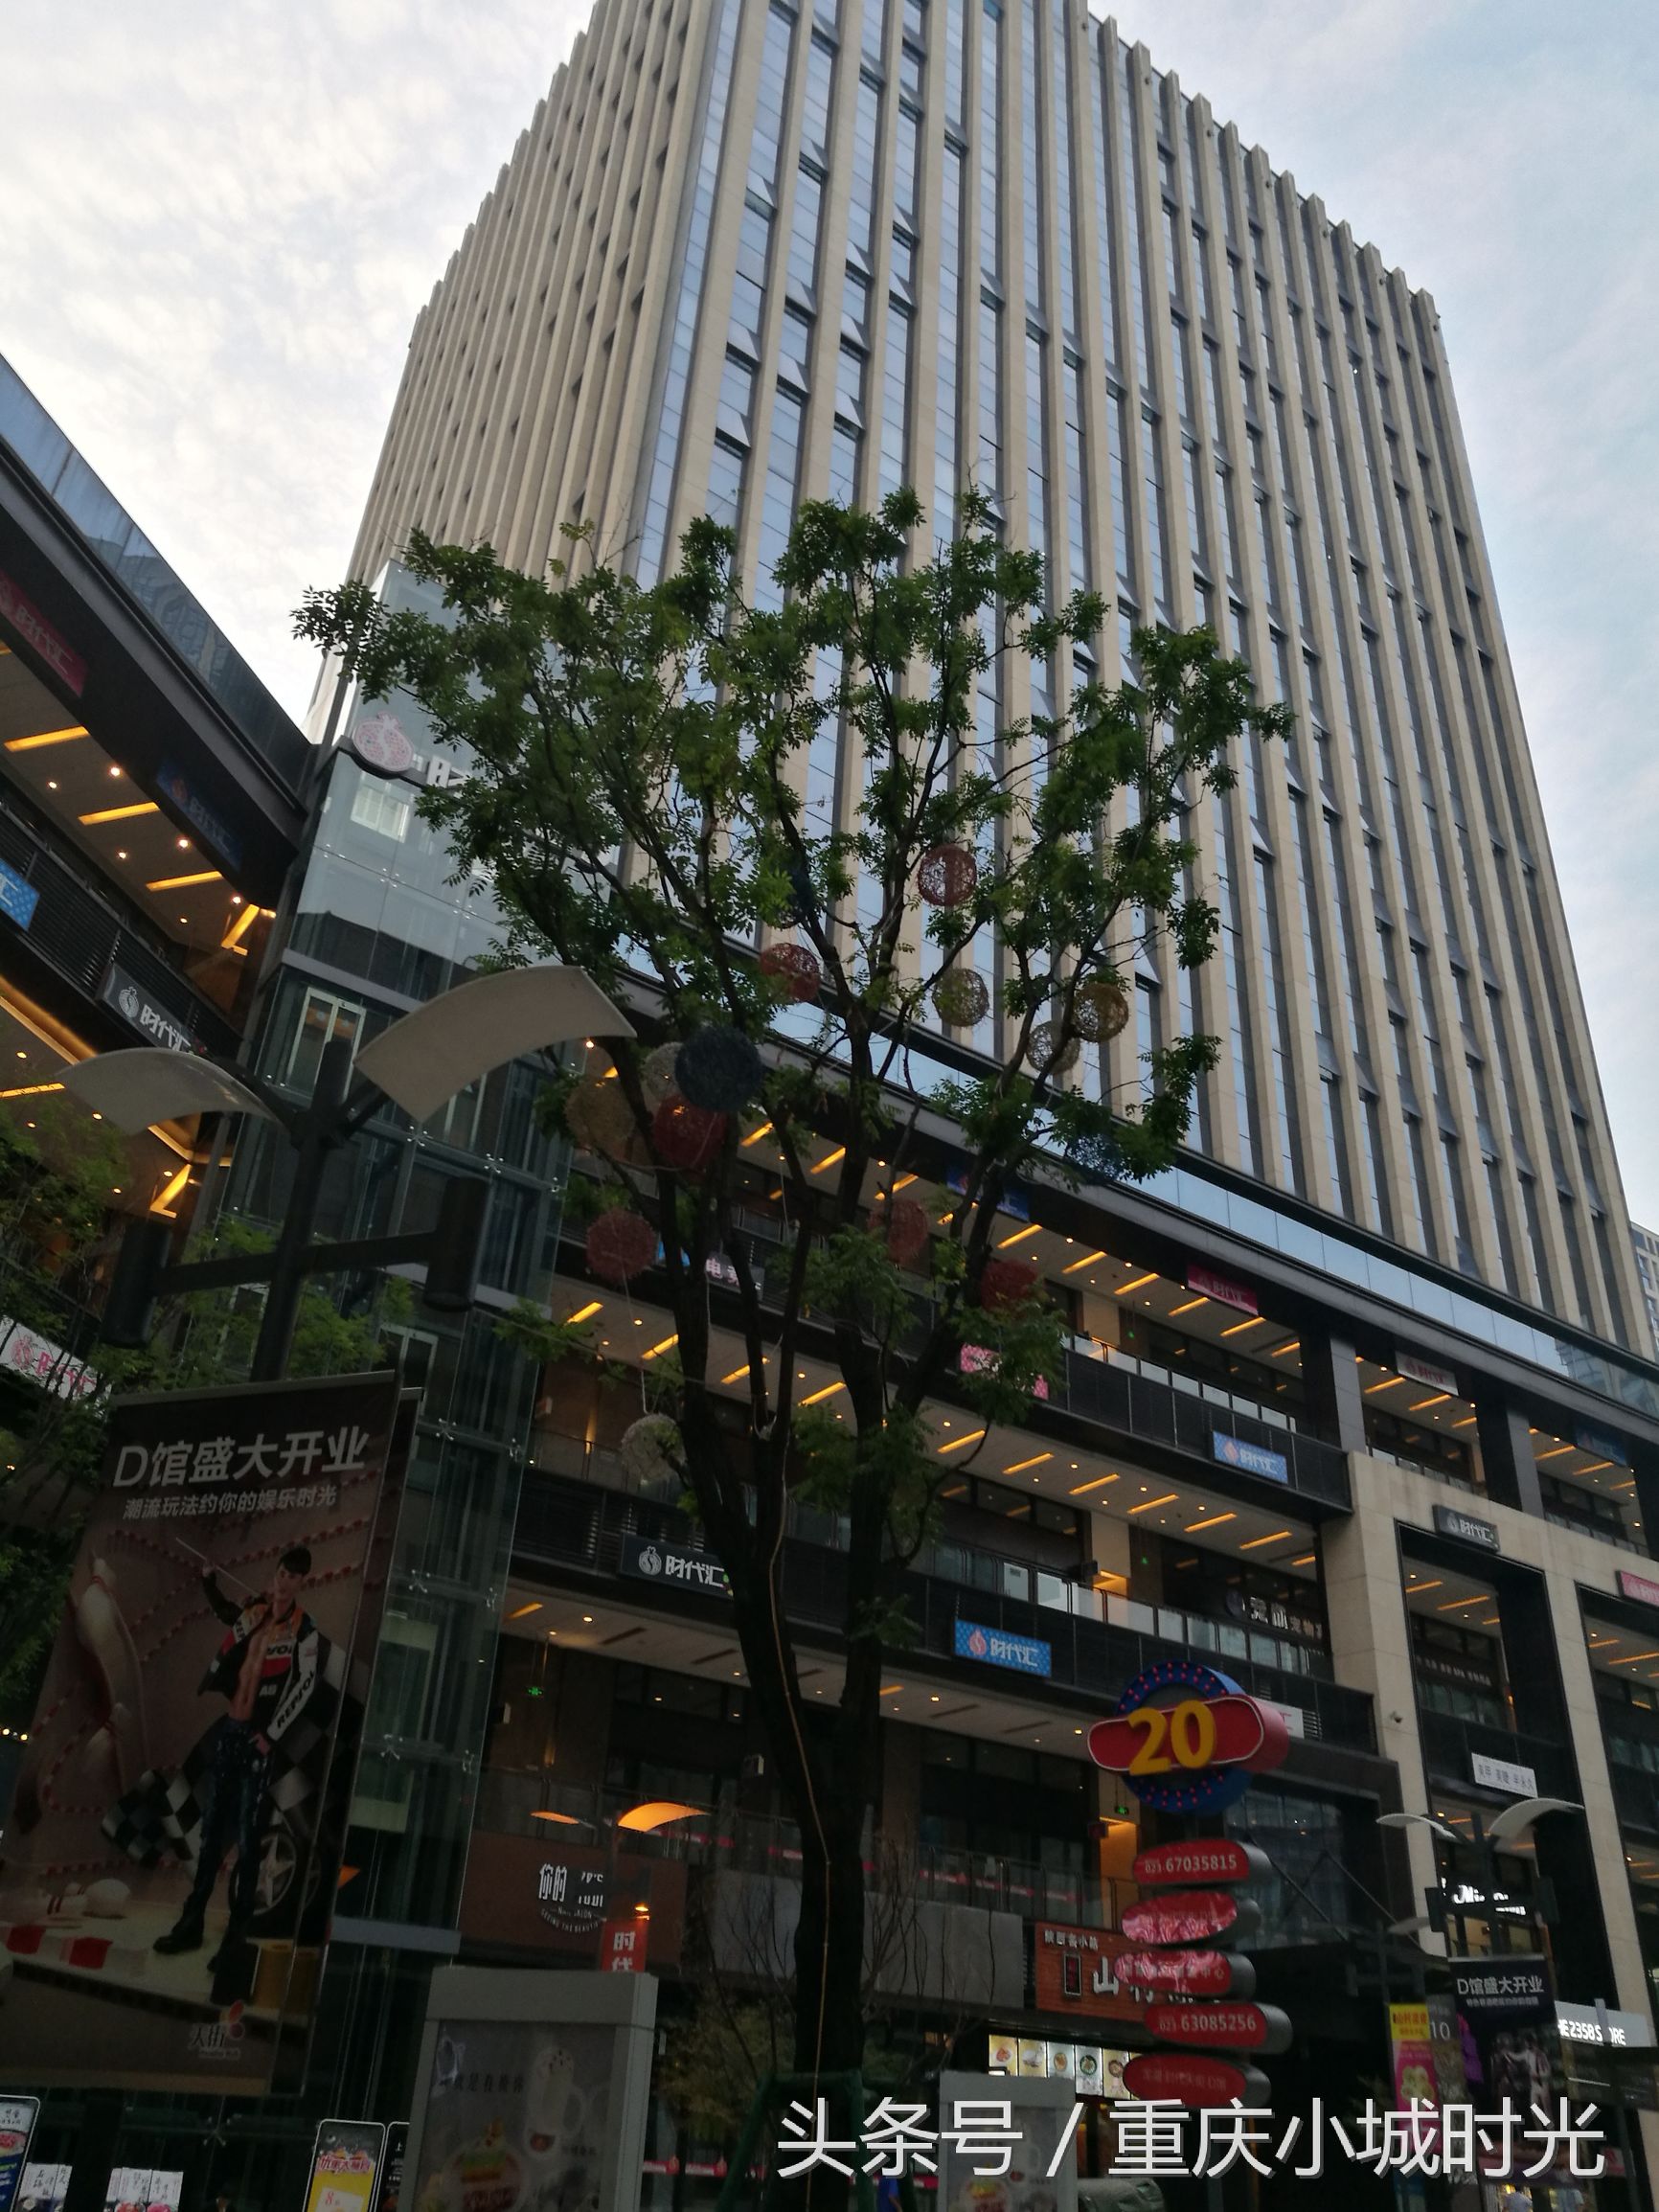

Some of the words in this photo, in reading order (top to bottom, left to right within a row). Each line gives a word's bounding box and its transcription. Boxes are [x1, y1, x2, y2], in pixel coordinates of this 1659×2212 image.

[113, 1425, 370, 1487] D馆盛大开业
[123, 1484, 336, 1520] 潮流玩法约你的娱乐时光
[664, 1554, 726, 1588] 时代汇
[989, 1636, 1039, 1668] 时代汇
[1126, 1699, 1216, 1776] 20
[1165, 1854, 1238, 1874] 67035815
[1456, 1974, 1545, 1995] D馆盛大开业
[1180, 2013, 1257, 2032] 63085256
